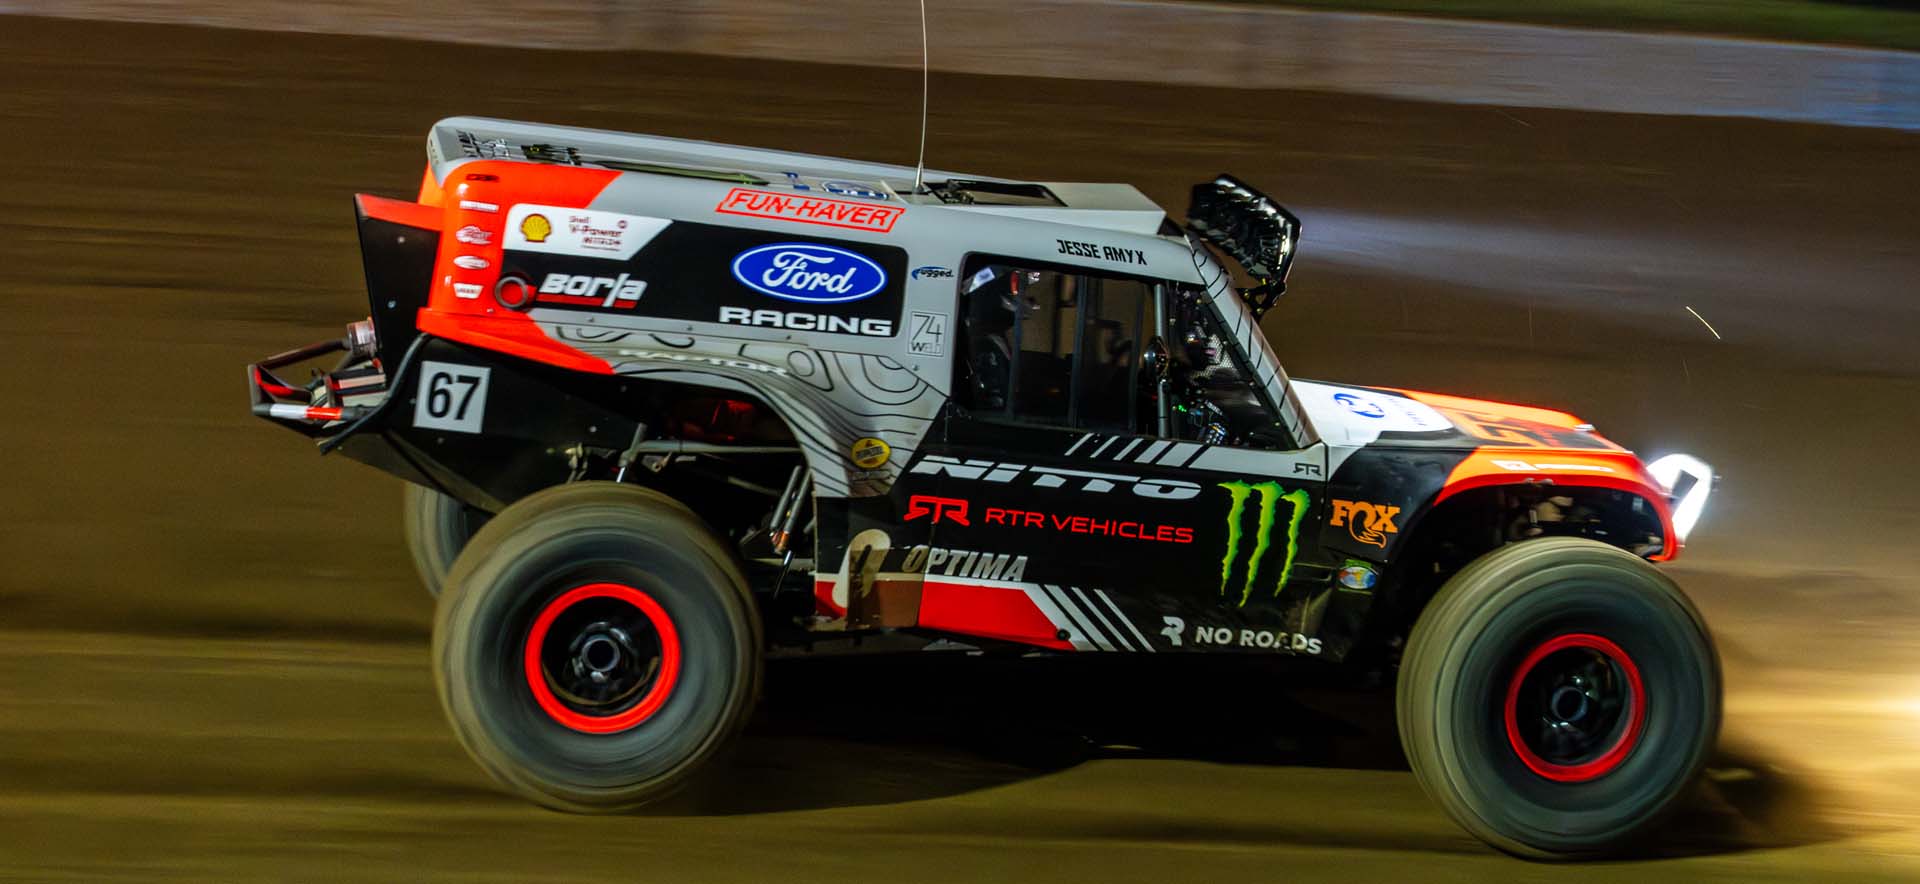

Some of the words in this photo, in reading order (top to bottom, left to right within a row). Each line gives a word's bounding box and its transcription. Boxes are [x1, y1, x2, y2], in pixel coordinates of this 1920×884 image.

[728, 192, 892, 226] FUN-HAVER
[1056, 239, 1101, 259] JESSE
[762, 251, 857, 294] Ford
[718, 305, 892, 336] RACING
[913, 314, 942, 343] 74
[427, 371, 482, 421] 67
[909, 454, 1202, 500] NITTO
[984, 507, 1045, 529] RTR
[1051, 514, 1194, 544] VEHICLES
[1329, 499, 1401, 549] FOX
[902, 544, 1028, 582] OPTIMA
[1195, 626, 1233, 645] NO
